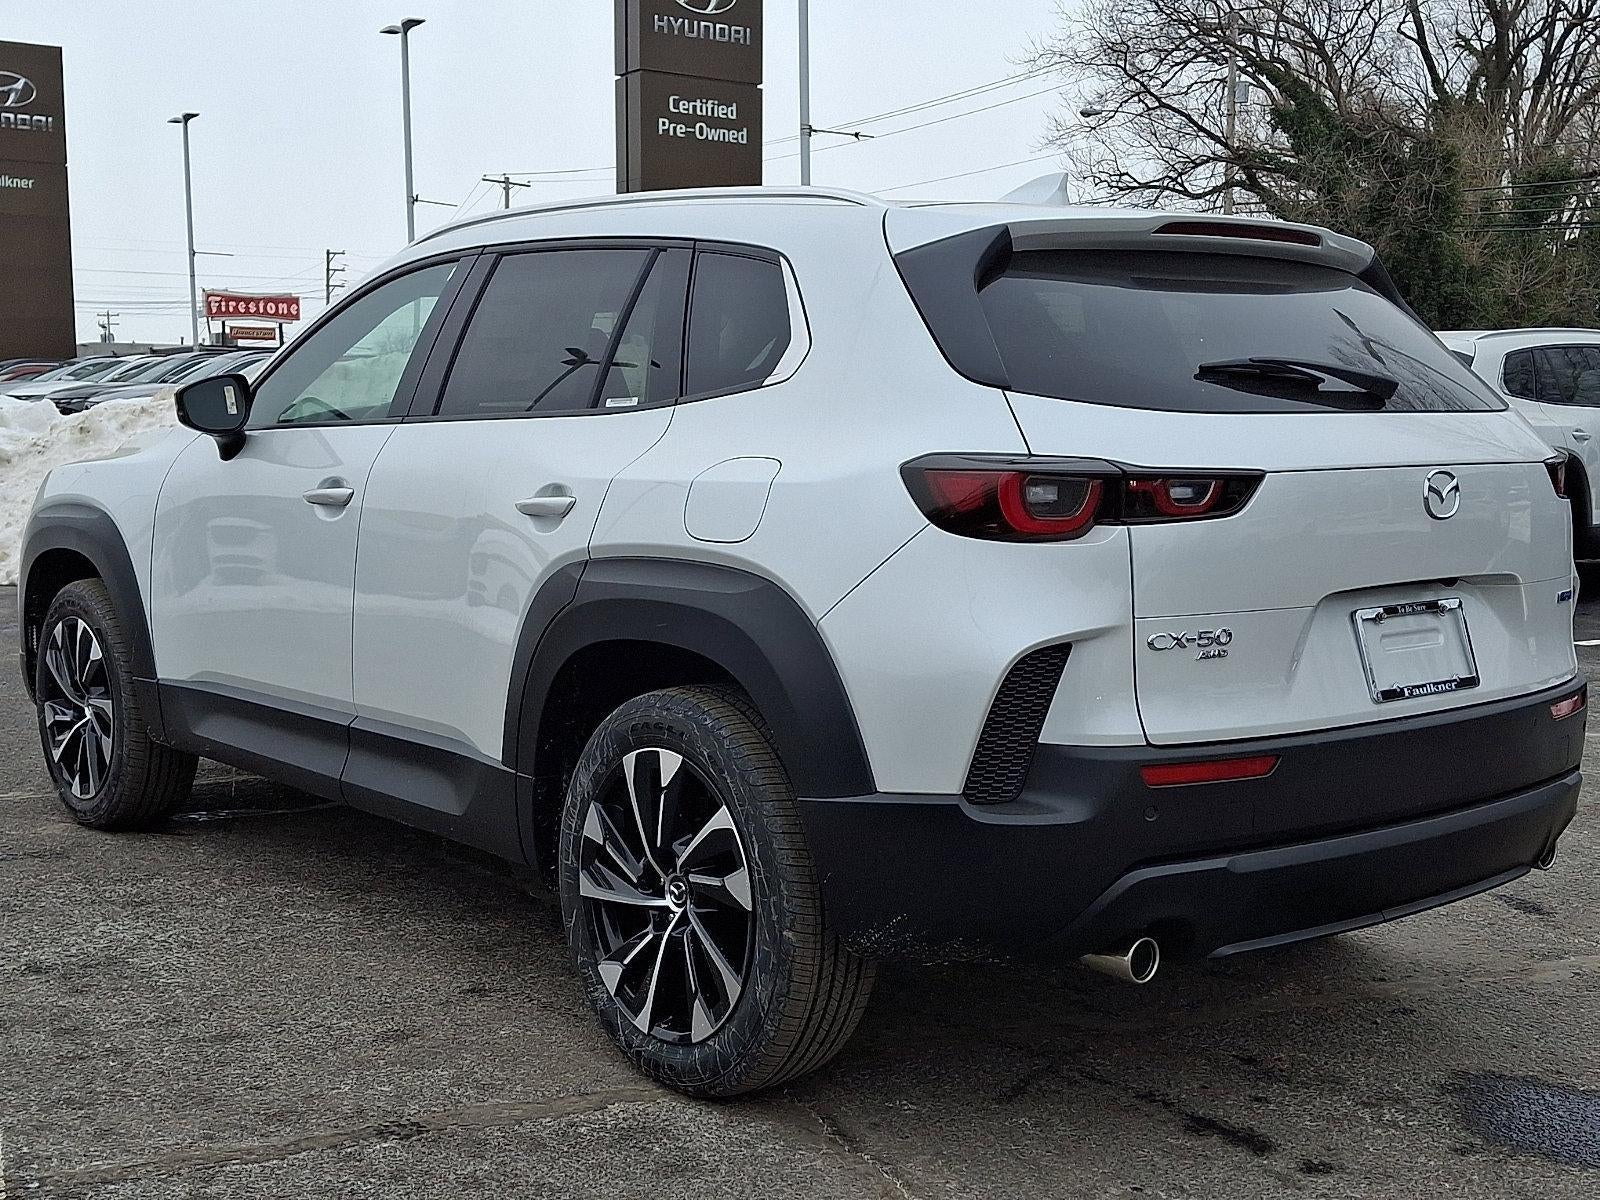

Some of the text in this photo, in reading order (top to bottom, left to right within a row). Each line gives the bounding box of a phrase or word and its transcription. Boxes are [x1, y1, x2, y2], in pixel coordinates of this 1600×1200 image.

[654, 14, 751, 45] HYUNDAI
[669, 95, 737, 120] Certified
[658, 118, 748, 144] Pre-Owned
[0, 175, 34, 189] lkner
[208, 296, 299, 315] Firestone
[1147, 627, 1233, 651] CX-50
[1403, 681, 1458, 697] Faulkner
